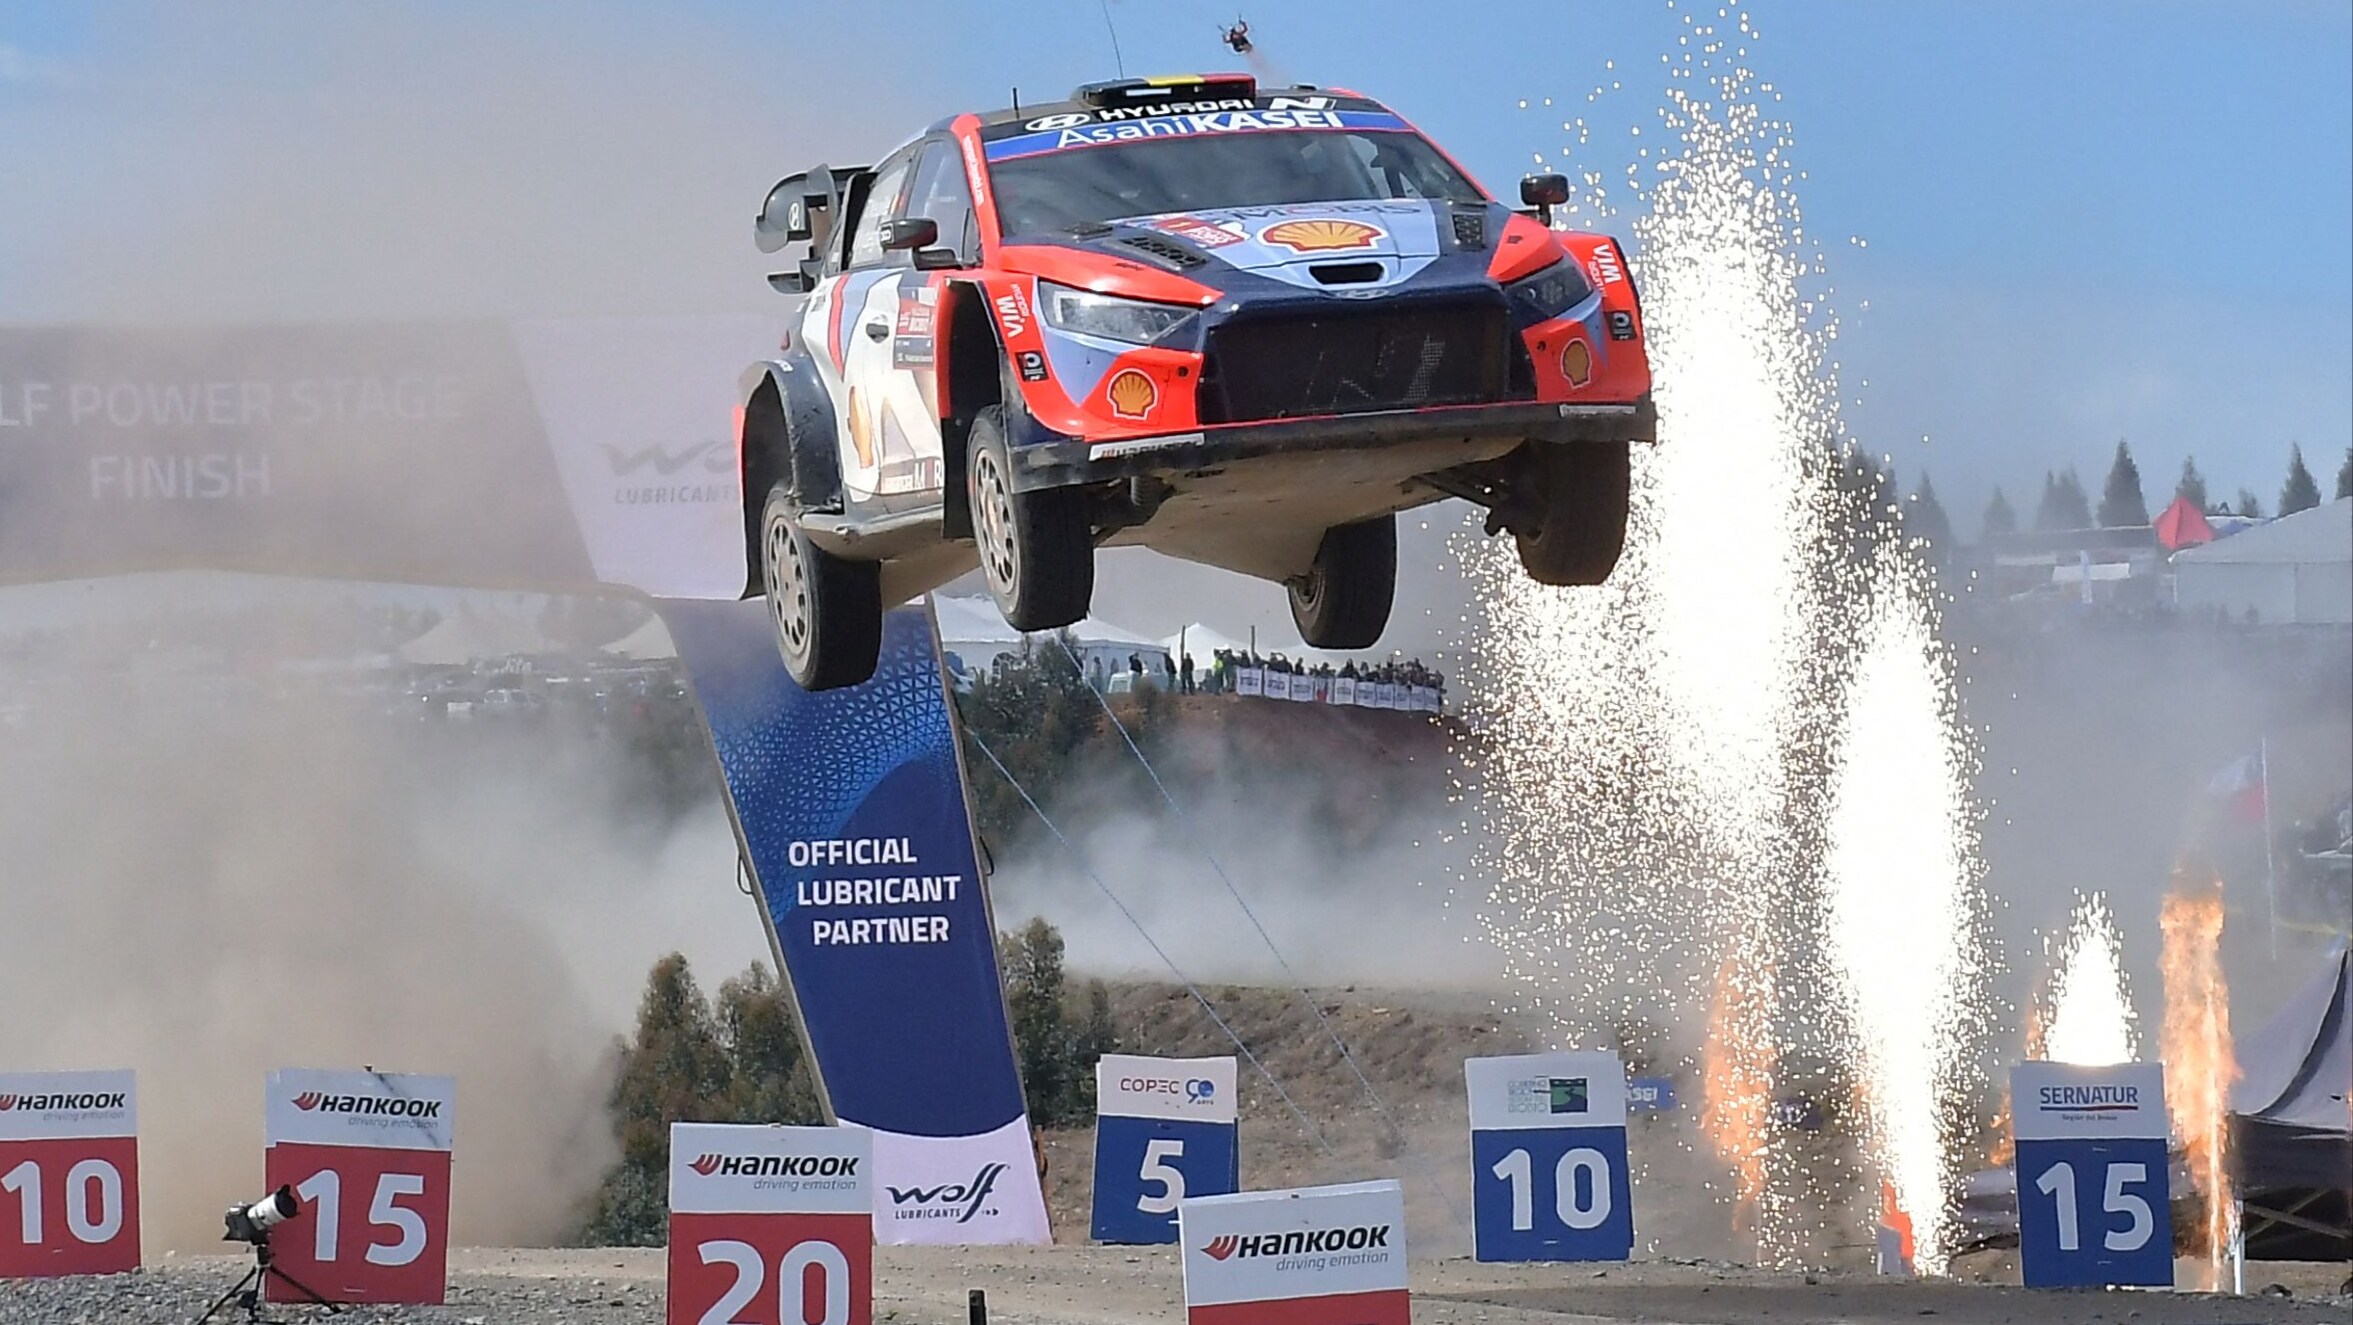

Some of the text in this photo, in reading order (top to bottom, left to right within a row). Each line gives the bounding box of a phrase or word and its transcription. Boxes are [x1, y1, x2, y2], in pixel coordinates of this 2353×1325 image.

[1100, 99, 1254, 121] HYUNDAI
[69, 380, 273, 427] POWER
[289, 375, 463, 423] STAGE
[89, 453, 273, 499] FINISH
[788, 837, 917, 867] OFFICIAL
[797, 876, 961, 907] LUBRICANT
[813, 916, 949, 945] PARTNER
[1120, 1077, 1180, 1095] COPEC
[2040, 1086, 2138, 1104] SERNATUR
[43, 1111, 124, 1122] driving emotion
[348, 1116, 438, 1129] driving emotion
[753, 1179, 857, 1192] driving emotion
[1136, 1139, 1186, 1214] 5
[1492, 1148, 1611, 1231] 10
[0, 1159, 123, 1244] 10
[895, 1208, 961, 1220] LUBRICANTS
[2036, 1162, 2153, 1251] 15
[297, 1169, 427, 1266] 15
[1276, 1251, 1389, 1271] driving emotion
[697, 1239, 849, 1325] 20
